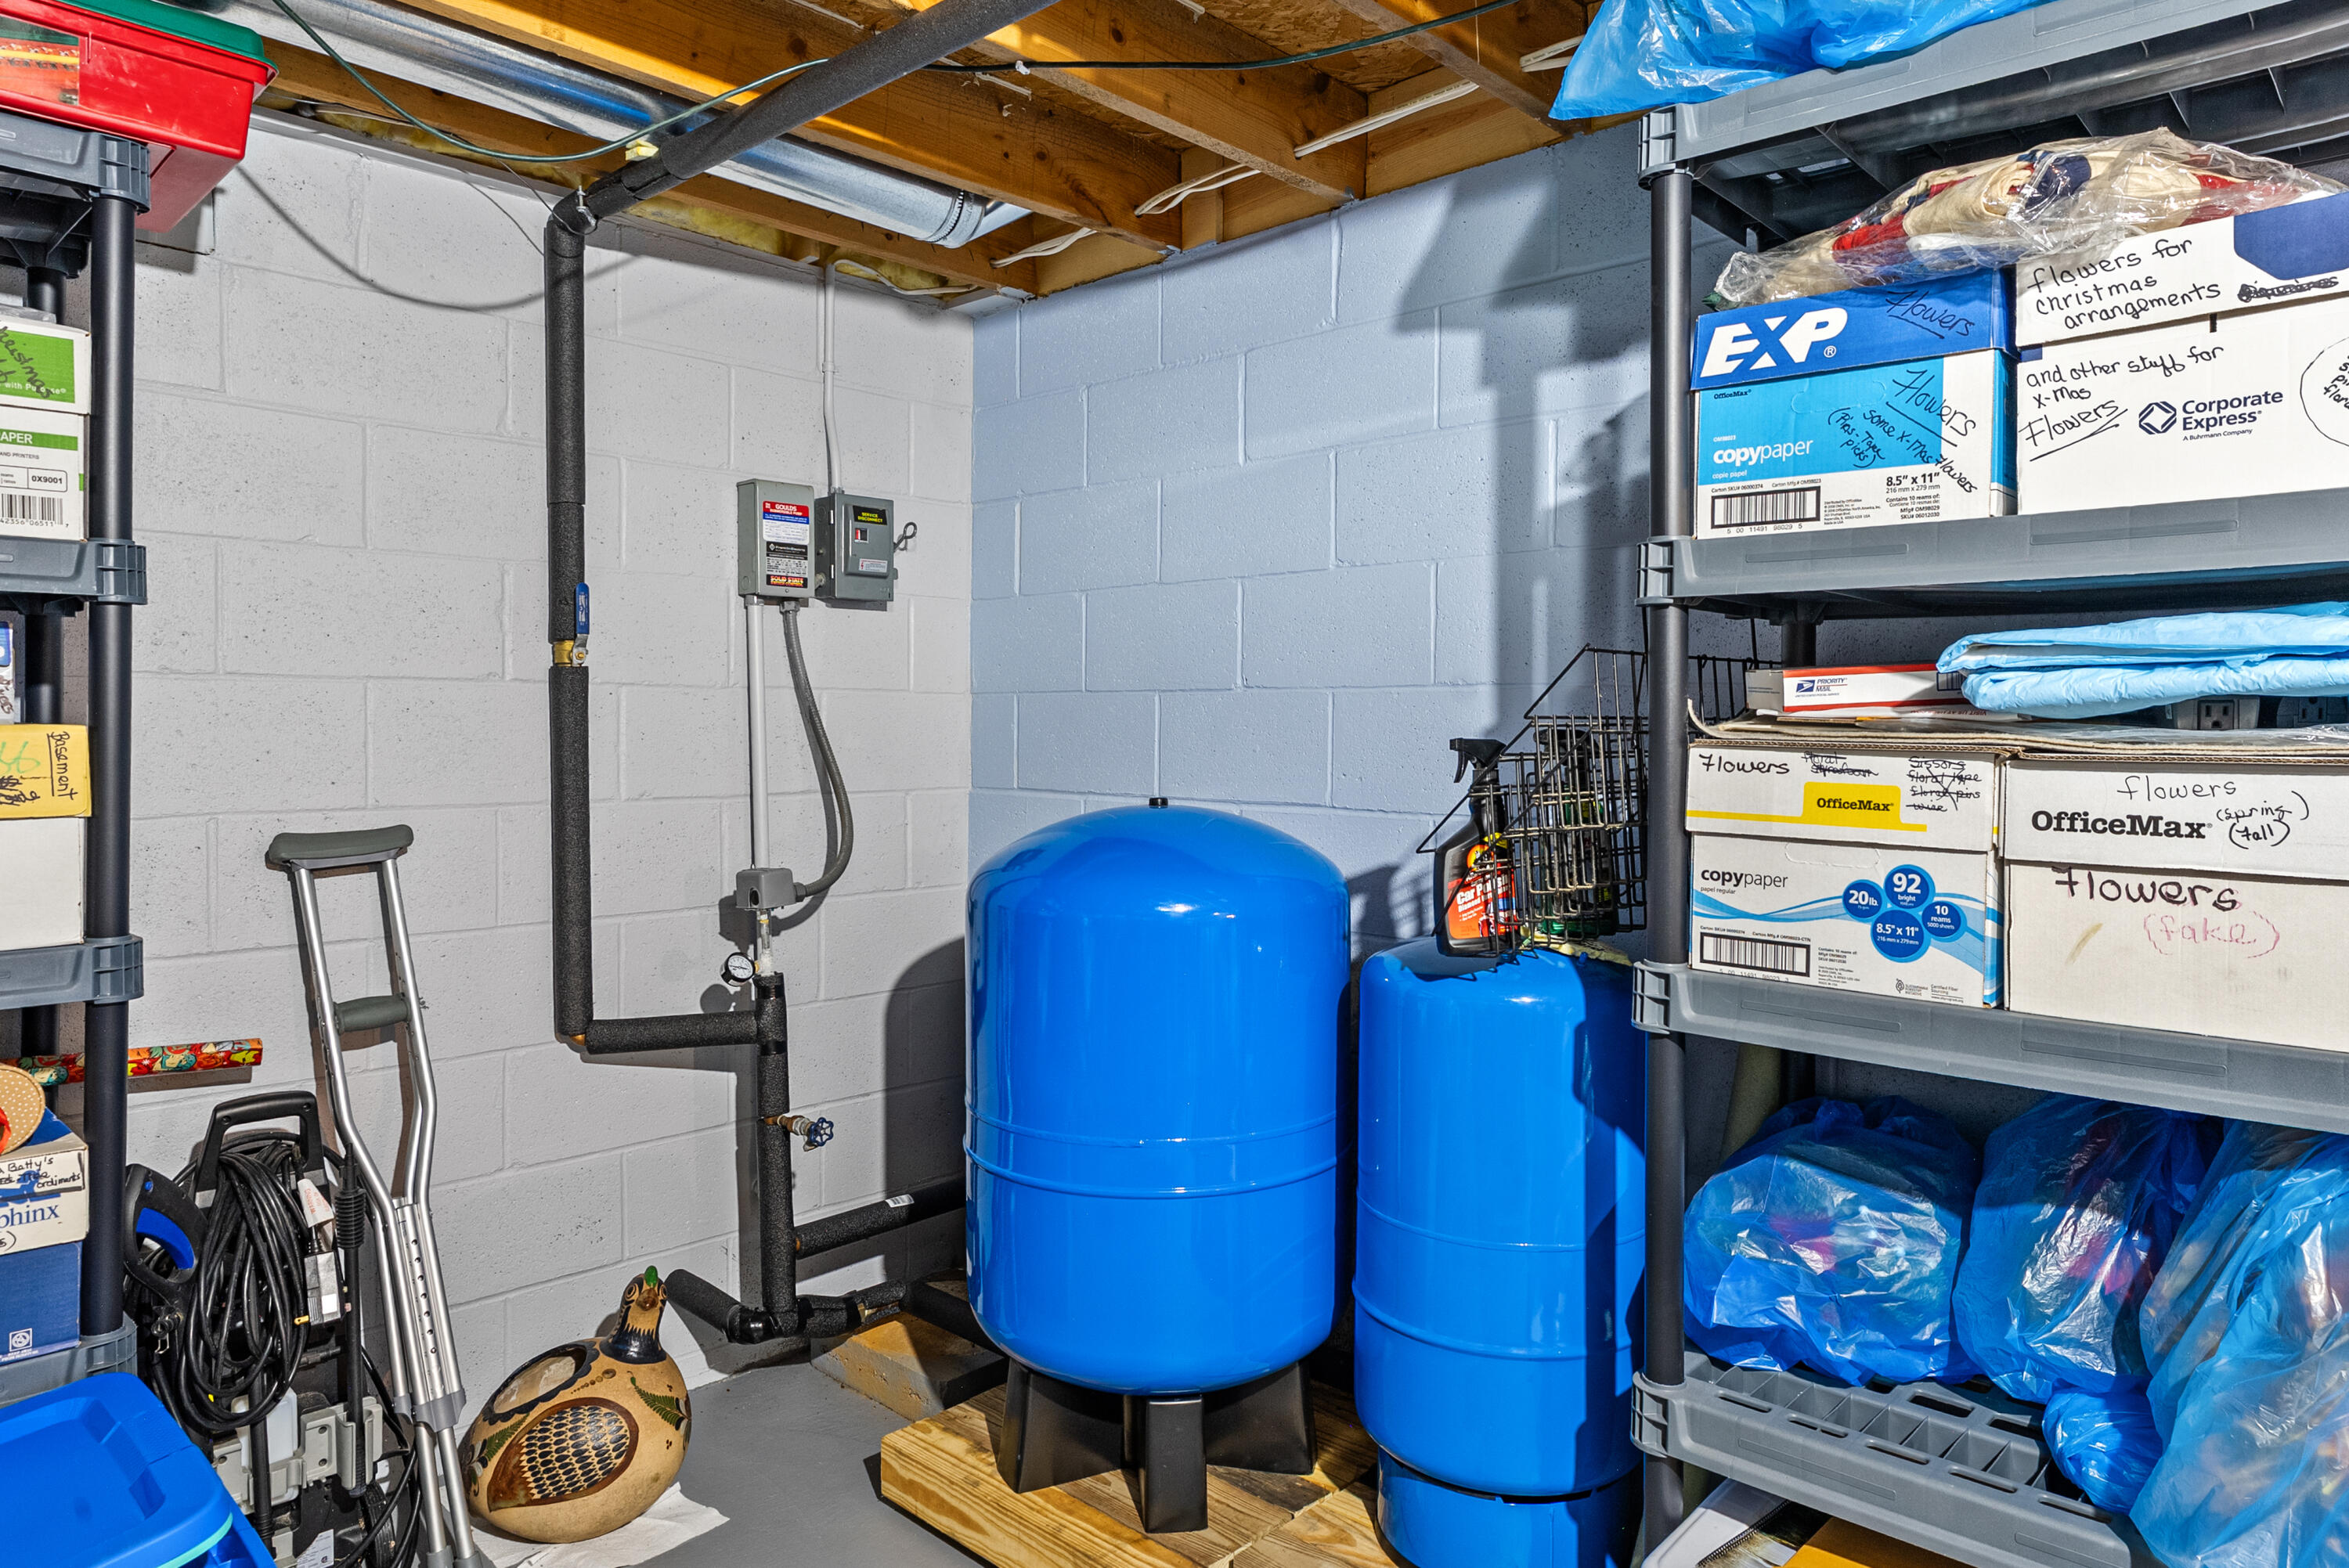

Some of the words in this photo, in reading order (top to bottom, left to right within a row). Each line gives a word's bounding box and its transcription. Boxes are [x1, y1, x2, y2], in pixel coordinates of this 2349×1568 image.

[2152, 238, 2192, 258] for
[2064, 282, 2221, 330] arrangements
[2026, 364, 2067, 388] and
[2070, 360, 2120, 381] other
[2127, 354, 2185, 377] stuff
[2187, 345, 2224, 366] for
[2181, 391, 2284, 416] Corporate
[0, 431, 33, 444] APER
[2188, 431, 2221, 442] Buhrmann
[2222, 428, 2253, 439] Company
[1713, 439, 1813, 467] copypaper
[52, 731, 78, 800] Basement
[1701, 868, 1788, 889] copypaper
[1893, 873, 1921, 894] 92
[1456, 889, 1475, 905] Car
[1701, 886, 1716, 895] papel
[1716, 887, 1736, 896] regular
[1935, 905, 1949, 915] 10
[1896, 927, 1903, 935] x
[0, 1205, 60, 1228] phinx
